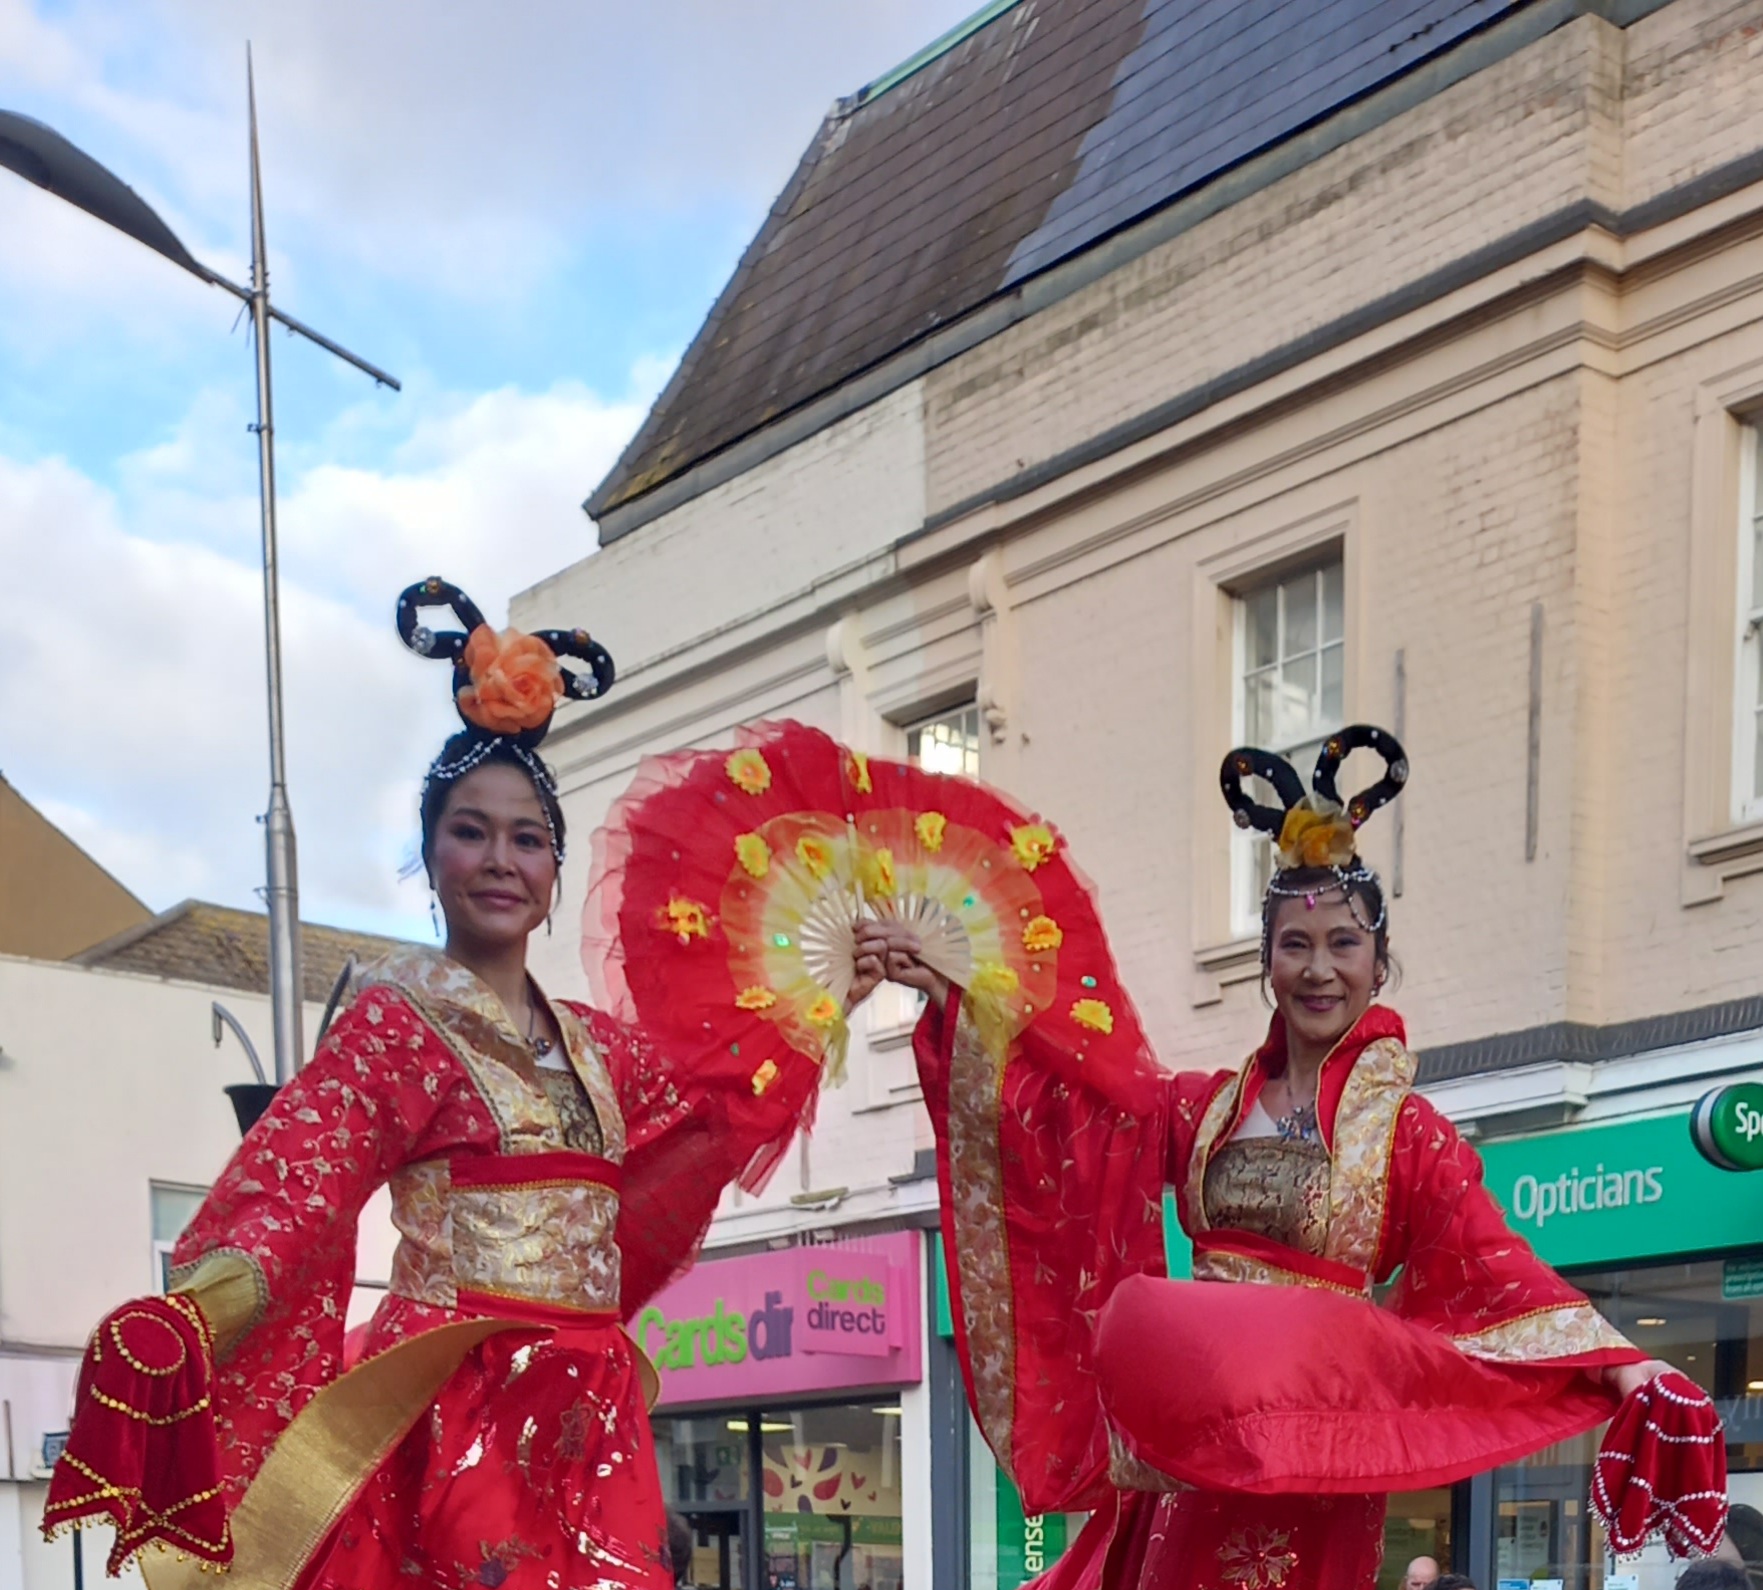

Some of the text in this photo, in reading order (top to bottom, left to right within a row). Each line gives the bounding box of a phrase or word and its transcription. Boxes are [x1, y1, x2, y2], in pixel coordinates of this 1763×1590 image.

[1513, 1163, 1664, 1228] Opticians
[806, 1270, 885, 1305] Cards
[807, 1301, 886, 1336] direct
[638, 1290, 795, 1370] Cards dir
[1024, 1513, 1044, 1577] ense
